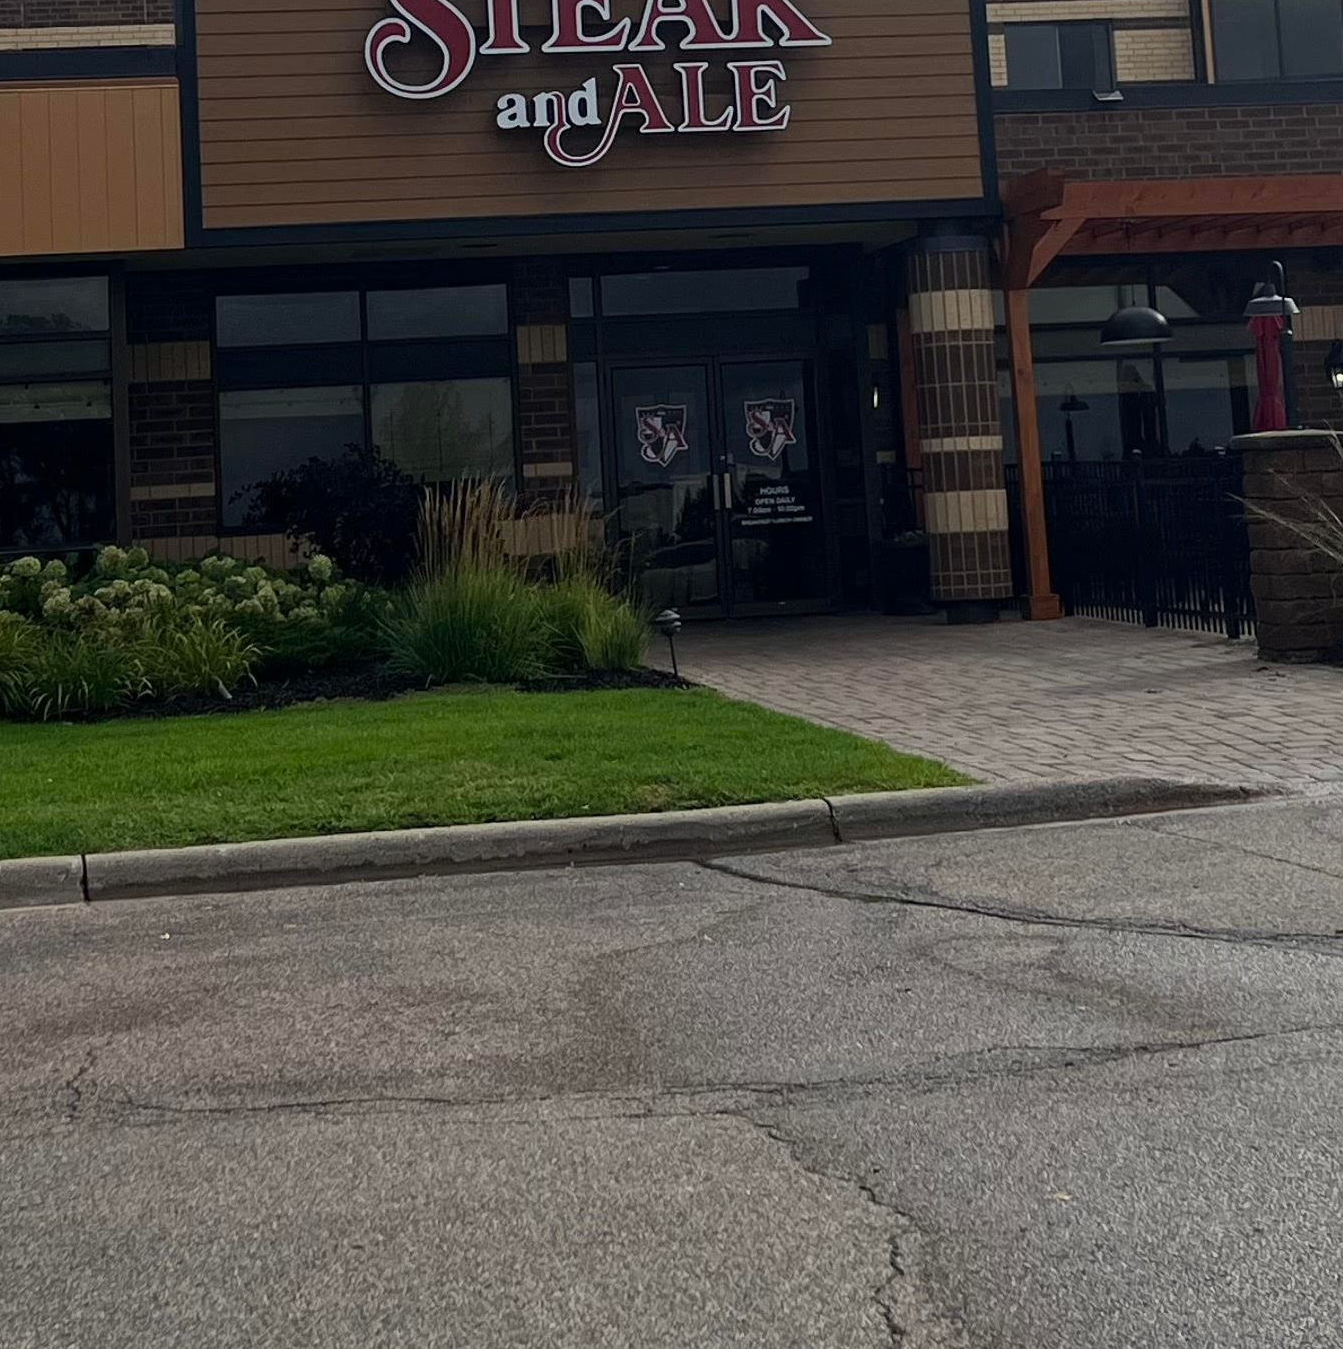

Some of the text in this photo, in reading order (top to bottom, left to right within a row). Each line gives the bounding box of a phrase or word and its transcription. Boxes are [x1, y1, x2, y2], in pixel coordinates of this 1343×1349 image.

[496, 61, 791, 167] and ALE
[760, 485, 789, 495] HOURS
